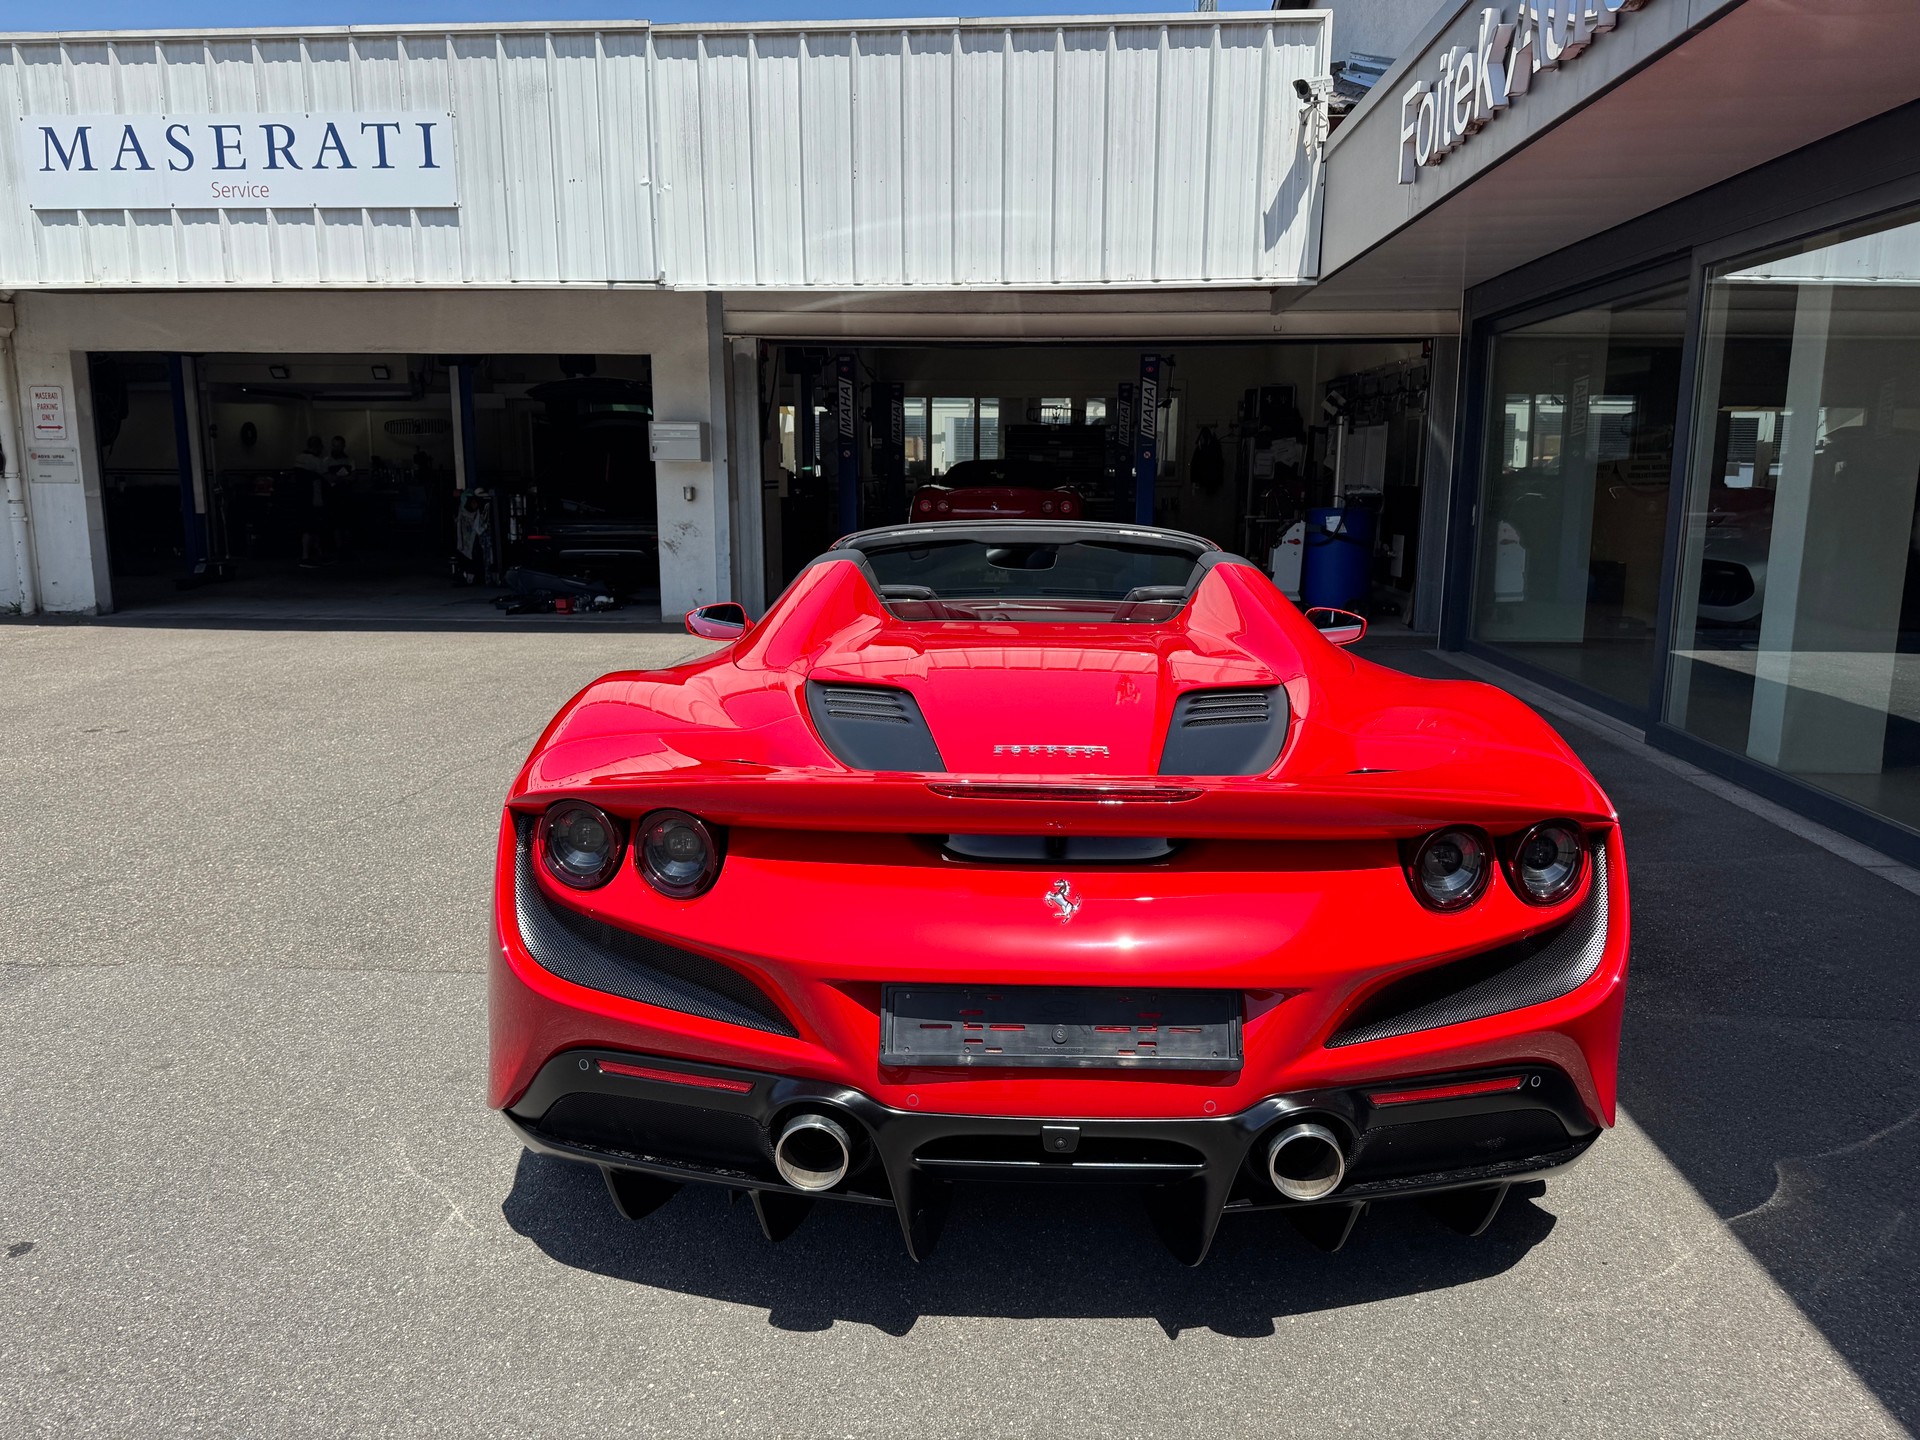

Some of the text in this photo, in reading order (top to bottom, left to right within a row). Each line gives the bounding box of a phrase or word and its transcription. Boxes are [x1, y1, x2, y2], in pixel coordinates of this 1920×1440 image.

[1398, 8, 1508, 185] Foitek
[38, 121, 441, 173] MASERATI
[211, 180, 270, 200] Service
[35, 392, 58, 400] MASERATI
[36, 403, 58, 411] PARKING
